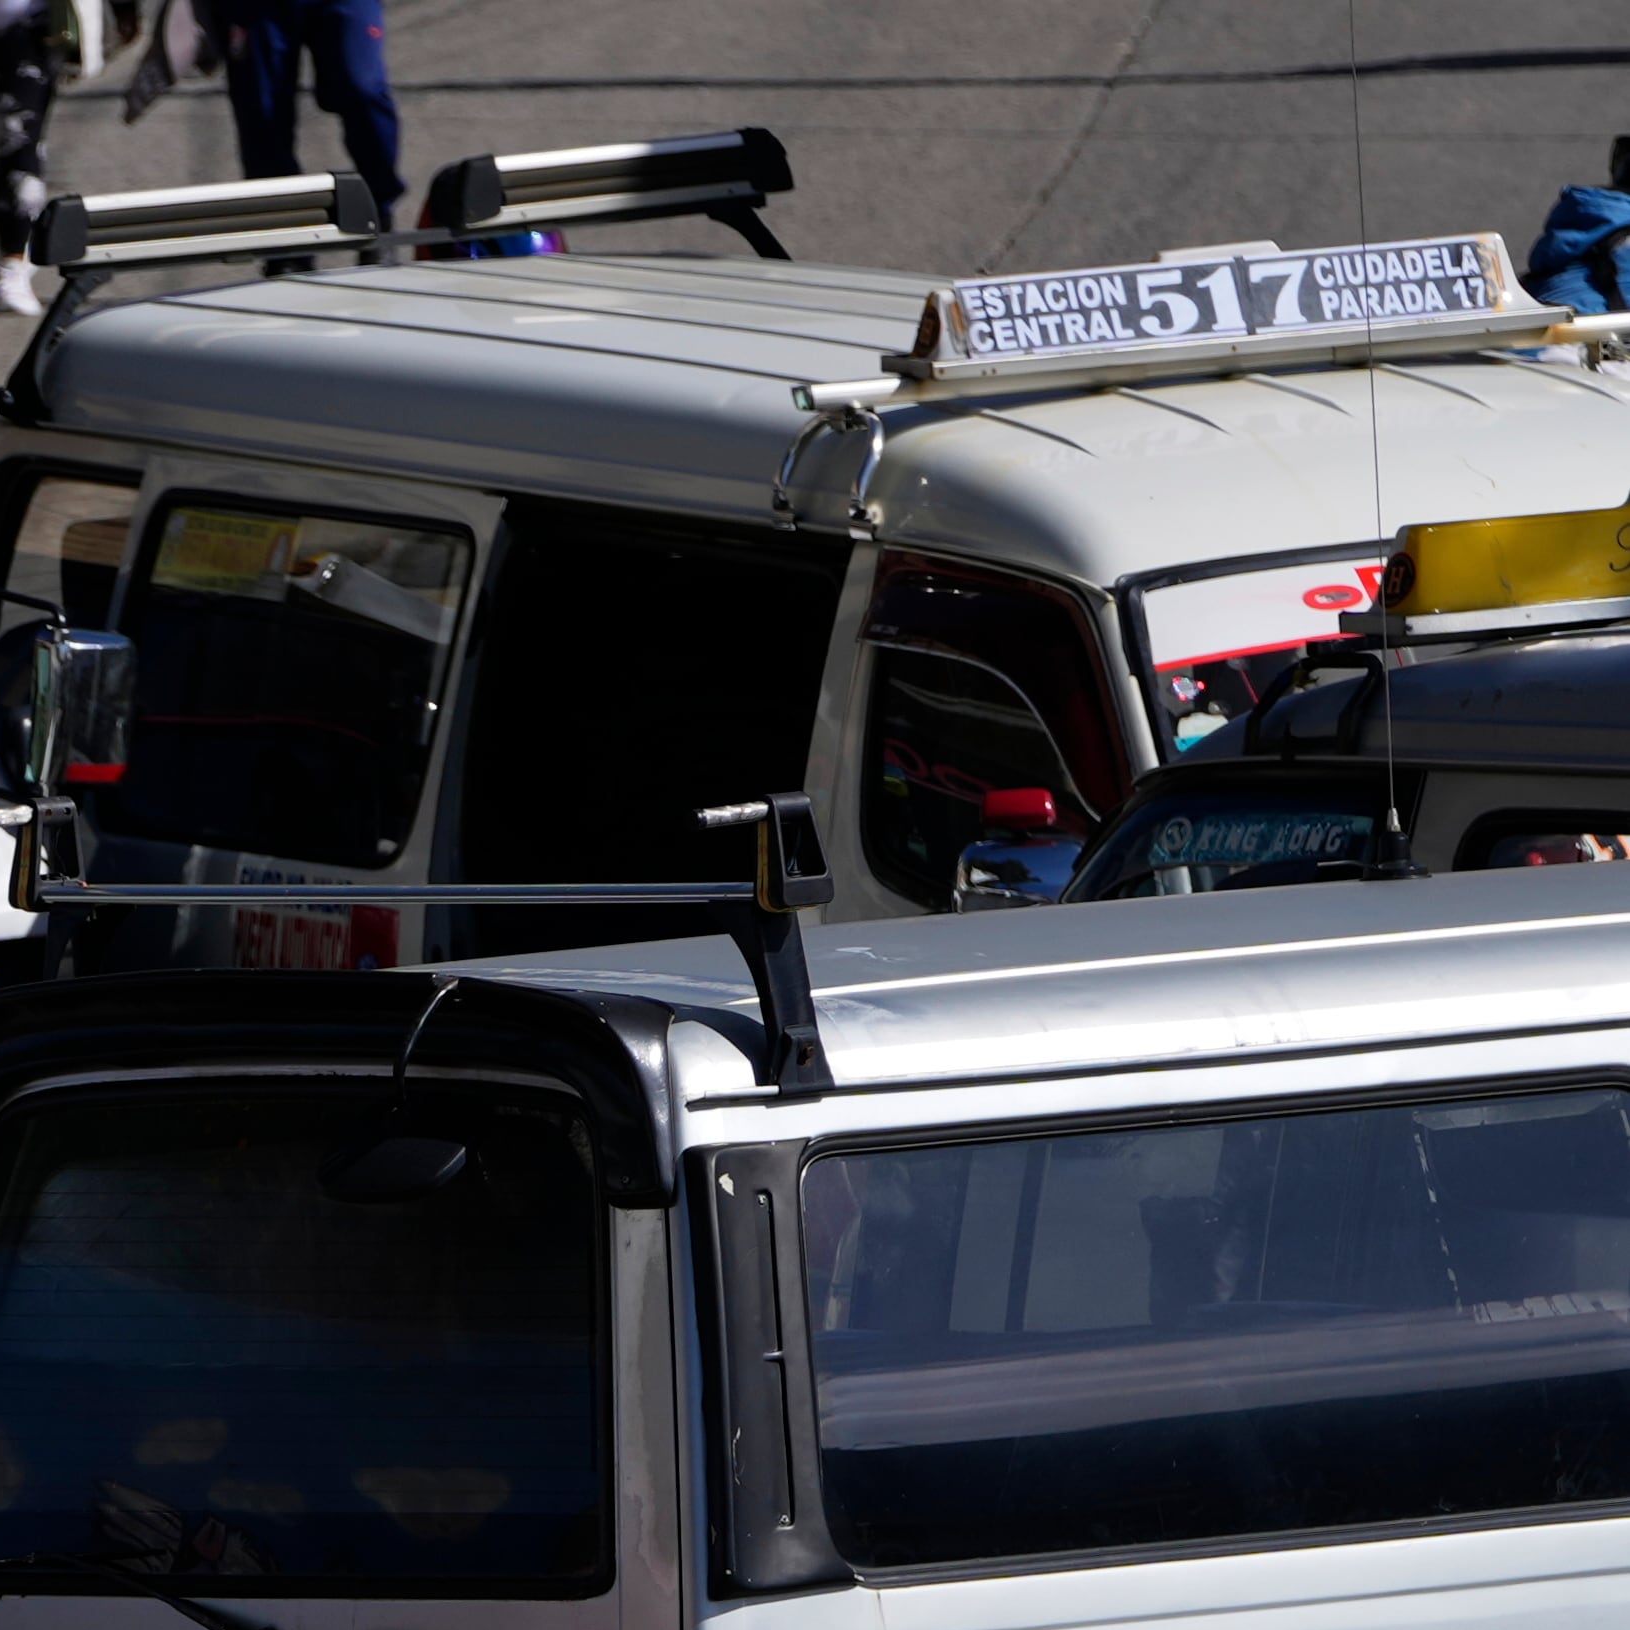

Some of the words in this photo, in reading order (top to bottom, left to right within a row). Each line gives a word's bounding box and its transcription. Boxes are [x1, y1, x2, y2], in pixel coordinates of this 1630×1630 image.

[1313, 244, 1482, 289] CIUDADELA
[961, 275, 1128, 320] ESTACION
[1136, 260, 1310, 337] 517
[1319, 281, 1448, 321] PARADA
[1452, 276, 1487, 309] 17
[969, 308, 1135, 352] CENTRAL
